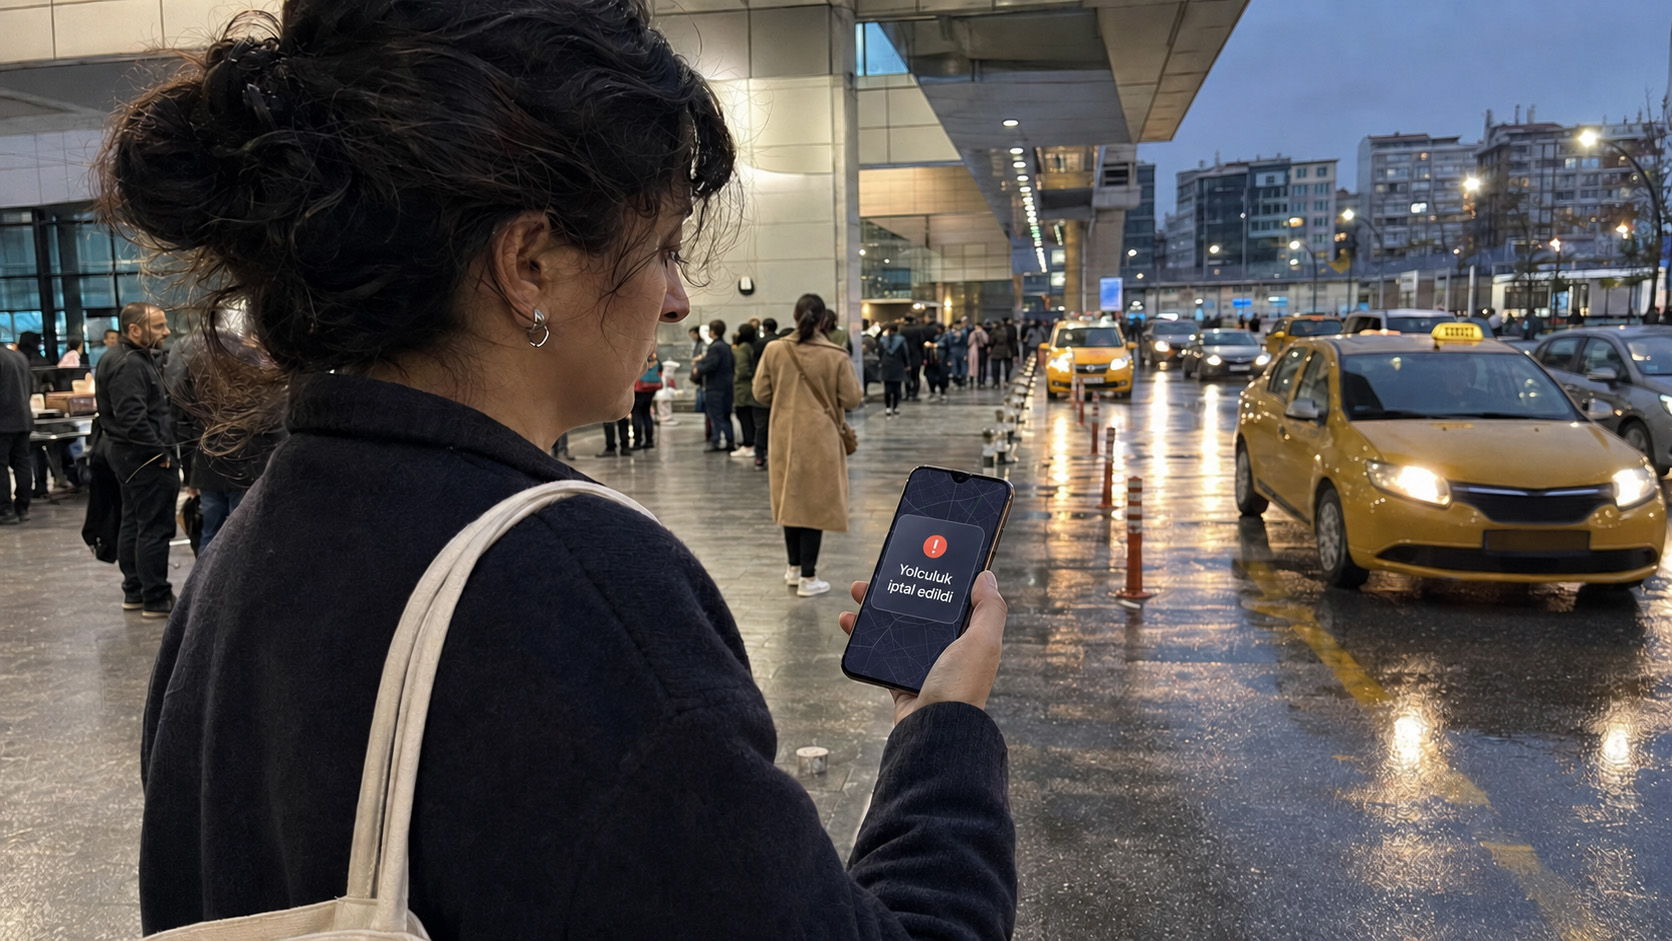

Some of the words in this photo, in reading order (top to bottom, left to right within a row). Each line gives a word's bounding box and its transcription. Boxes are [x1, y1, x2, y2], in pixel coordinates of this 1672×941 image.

[900, 563, 953, 585] Yolculuk
[887, 579, 916, 596] iptal
[917, 587, 954, 603] edildi
